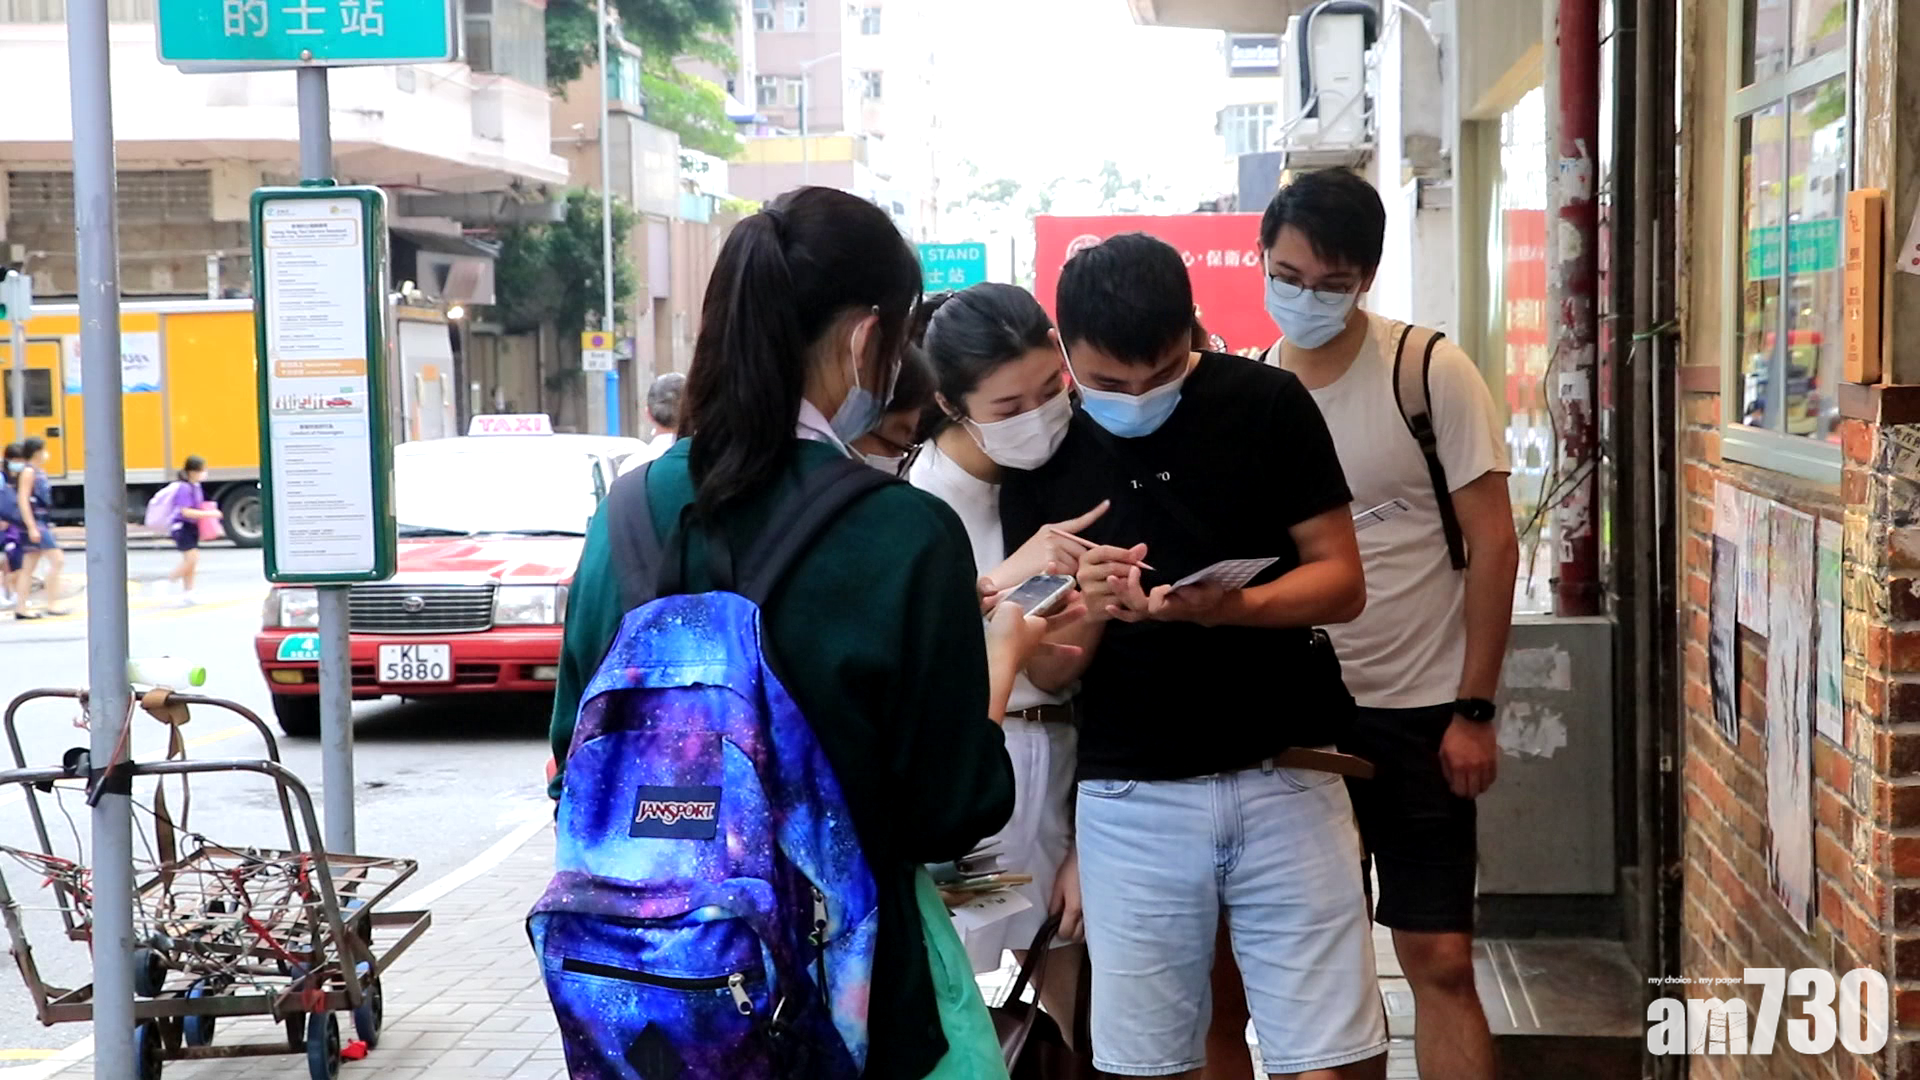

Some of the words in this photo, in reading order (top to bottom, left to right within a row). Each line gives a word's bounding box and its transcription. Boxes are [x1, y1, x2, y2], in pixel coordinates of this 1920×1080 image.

[223, 0, 385, 37] 的士站
[927, 247, 980, 262] STAND
[478, 417, 542, 433] TAXI
[301, 638, 315, 651] 4
[400, 644, 428, 663] KL
[386, 662, 444, 681] 5880
[635, 800, 716, 825] JANSPORT
